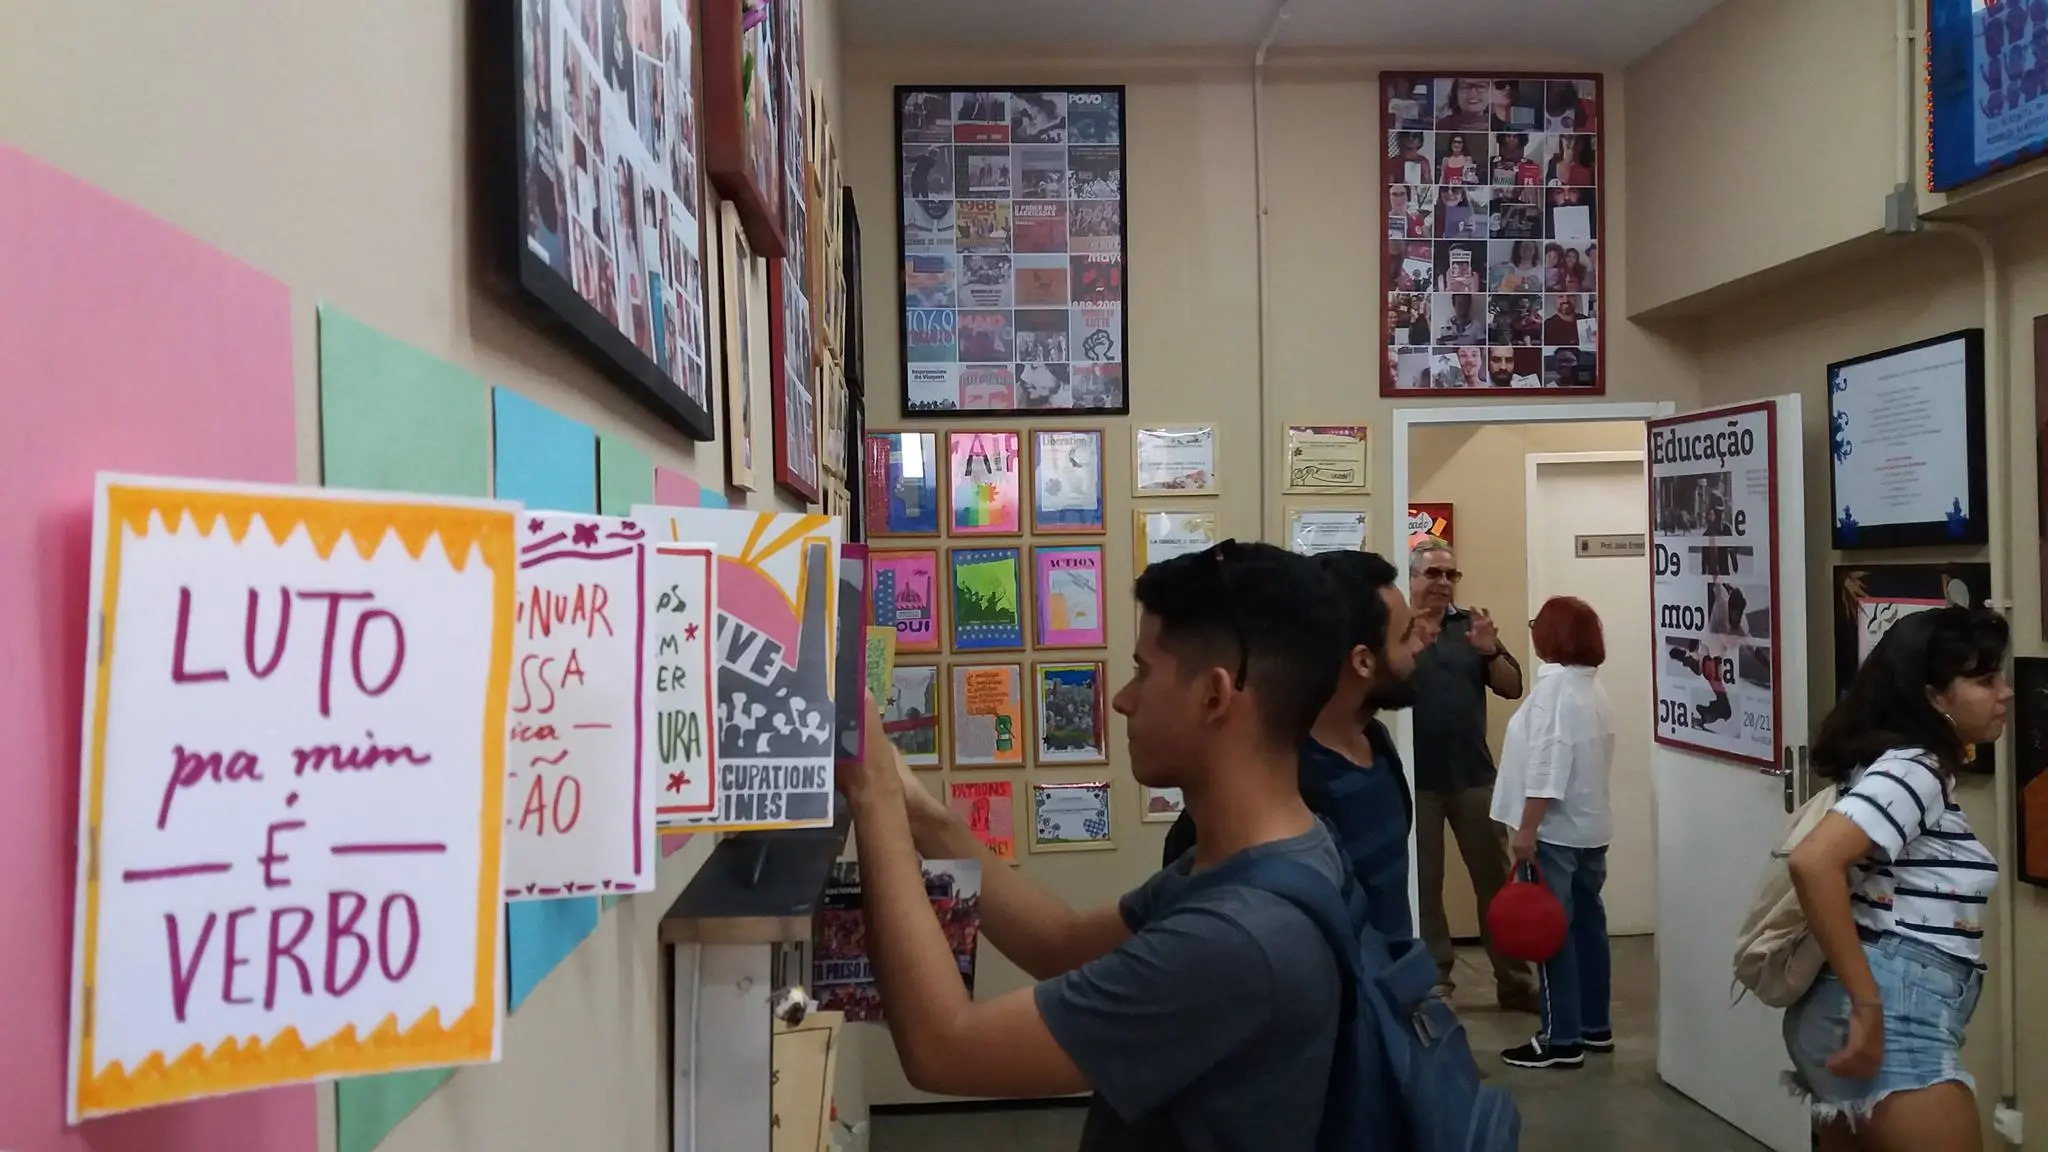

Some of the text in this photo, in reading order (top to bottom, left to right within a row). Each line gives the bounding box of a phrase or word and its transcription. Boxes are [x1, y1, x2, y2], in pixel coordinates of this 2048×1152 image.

[1069, 94, 1101, 105] POVO
[1652, 420, 1754, 468] Educação
[1734, 508, 1746, 536] e
[1050, 559, 1095, 568] ACTION
[171, 586, 406, 717] LUTO
[657, 709, 702, 765] URA
[157, 742, 263, 829] pra
[507, 749, 581, 837] ÃO
[717, 763, 827, 791] CUPATIONS
[718, 792, 783, 822] INES
[257, 791, 307, 889] É
[163, 889, 421, 1023] VERBO
